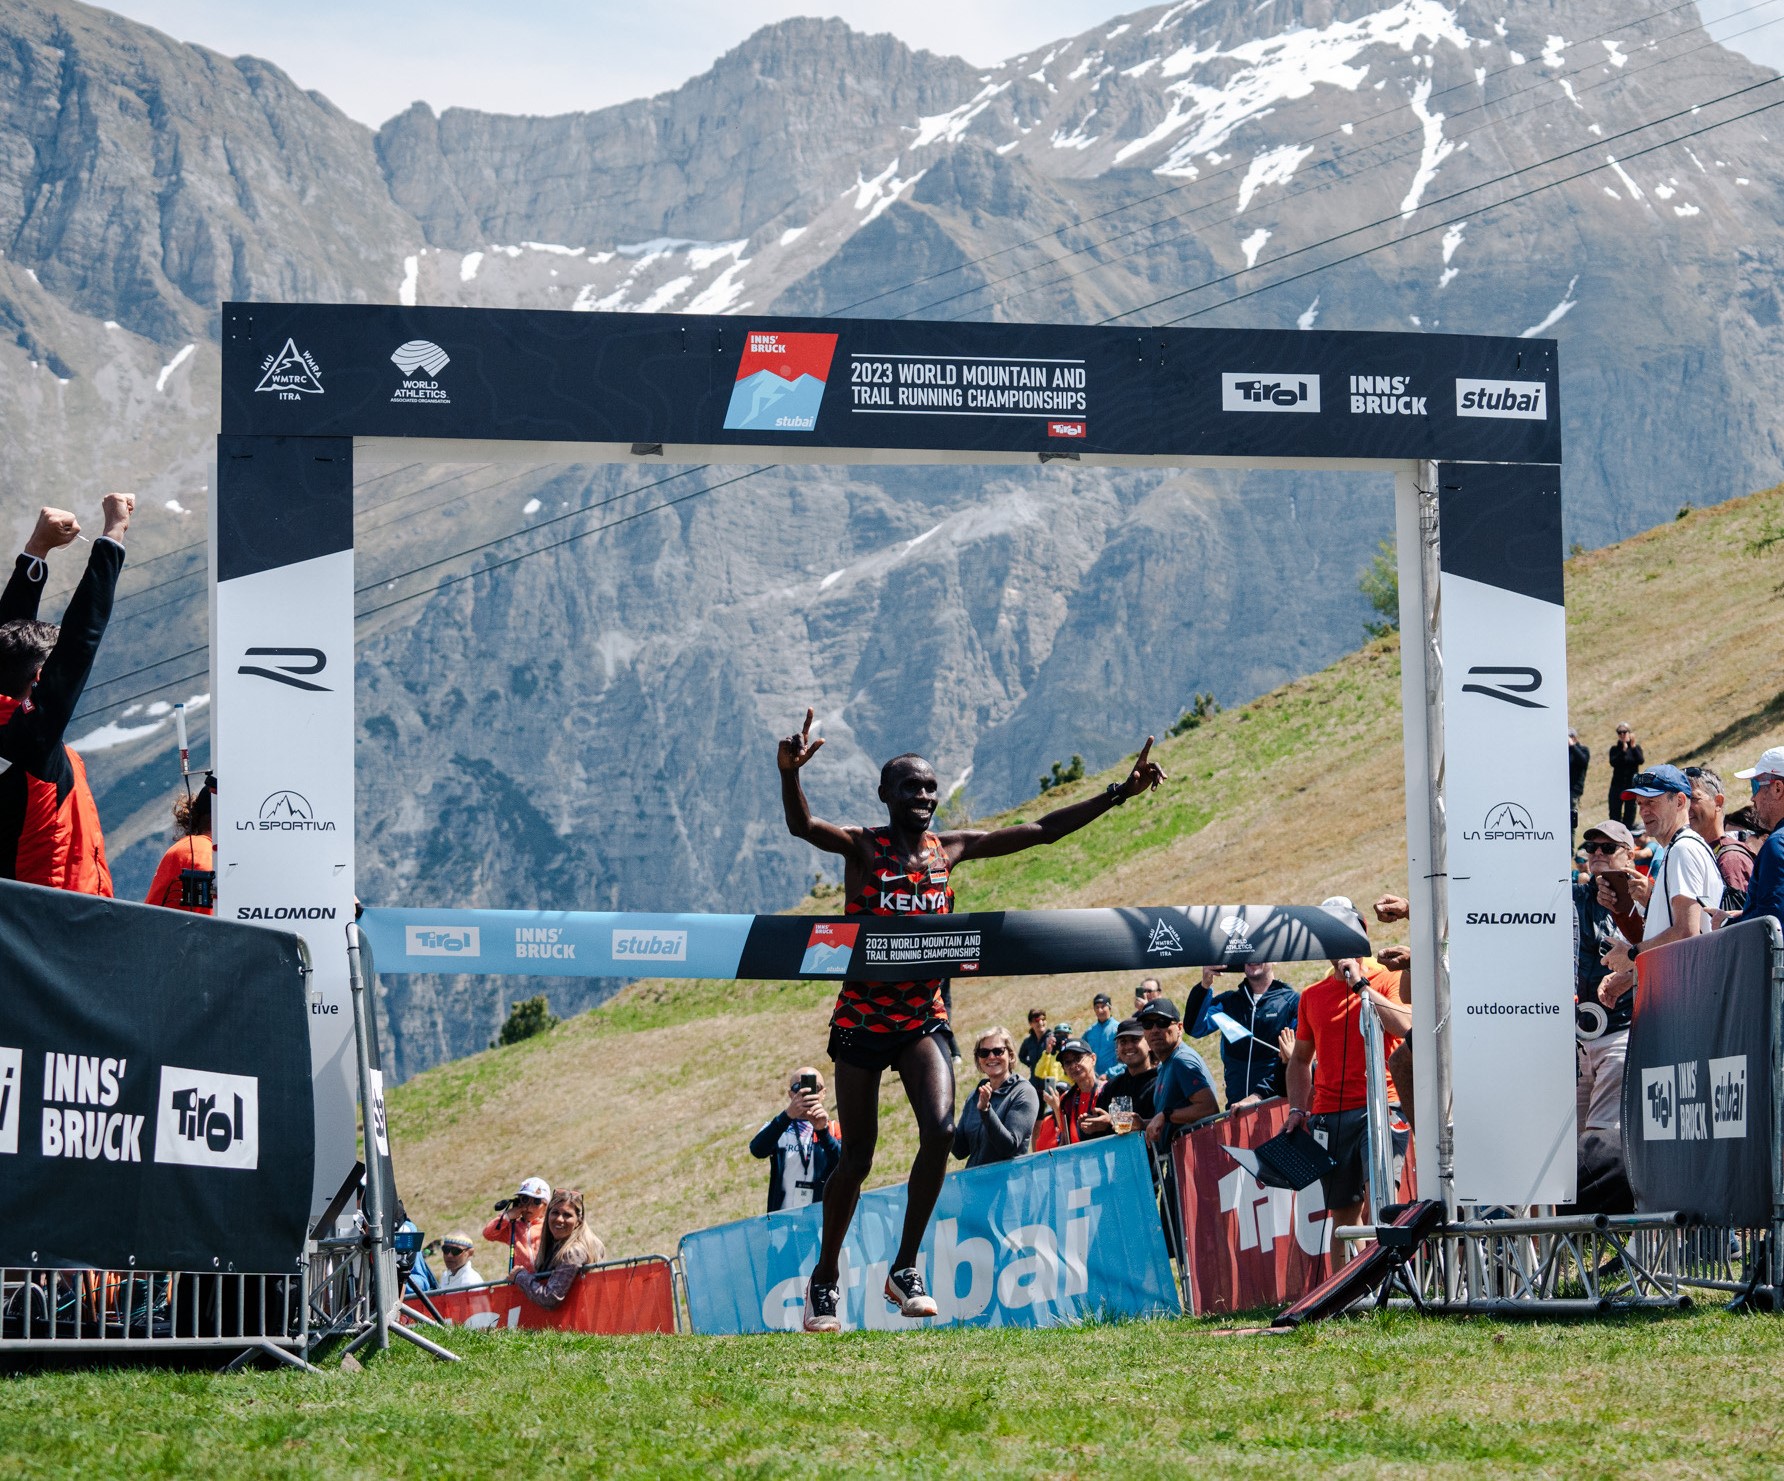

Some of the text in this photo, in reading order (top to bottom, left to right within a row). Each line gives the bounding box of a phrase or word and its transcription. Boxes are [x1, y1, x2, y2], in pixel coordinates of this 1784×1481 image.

[751, 335, 779, 344] INNS'
[751, 344, 786, 353] BRUCK
[260, 354, 275, 371] IAU
[302, 350, 322, 379] WMRA
[271, 375, 307, 383] WMTRC
[851, 362, 1086, 389] 2023 WORLD MOUNTAIN AND
[402, 380, 439, 390] WORLD
[1234, 380, 1308, 407] Tirol
[1350, 375, 1410, 395] INNS'
[279, 392, 301, 401] ITRA
[393, 389, 448, 399] ATHLETICS
[851, 385, 1087, 411] TRAIL RUNNING CHAMPIONSHIPS
[1460, 387, 1541, 413] stubai
[1350, 395, 1428, 416] BRUCK
[774, 415, 815, 429] stubai
[1053, 424, 1082, 436] Tirol
[236, 821, 336, 831] LA SPORTIVA
[1463, 831, 1555, 841] LA SPORTIVA
[880, 891, 945, 911] KENYA
[236, 907, 337, 920] SALOMON
[1465, 912, 1557, 925] SALOMON
[415, 931, 471, 953] Tirol
[515, 926, 563, 943] INNS'
[865, 934, 981, 950] 2023 WORLD MOUNTAIN AND
[515, 943, 576, 960] BRUCK
[615, 935, 683, 956] stubai
[865, 946, 981, 961] TRAIL RUNNING CHAMPIONSHIPS
[1466, 1002, 1560, 1015] outdooractive
[43, 1051, 127, 1107] INNS'
[1677, 1060, 1699, 1099] INNS'
[1714, 1069, 1745, 1123] stubai
[171, 1086, 244, 1152] Tirol
[1679, 1102, 1708, 1141] BRUCK
[42, 1107, 145, 1163] BRUCK
